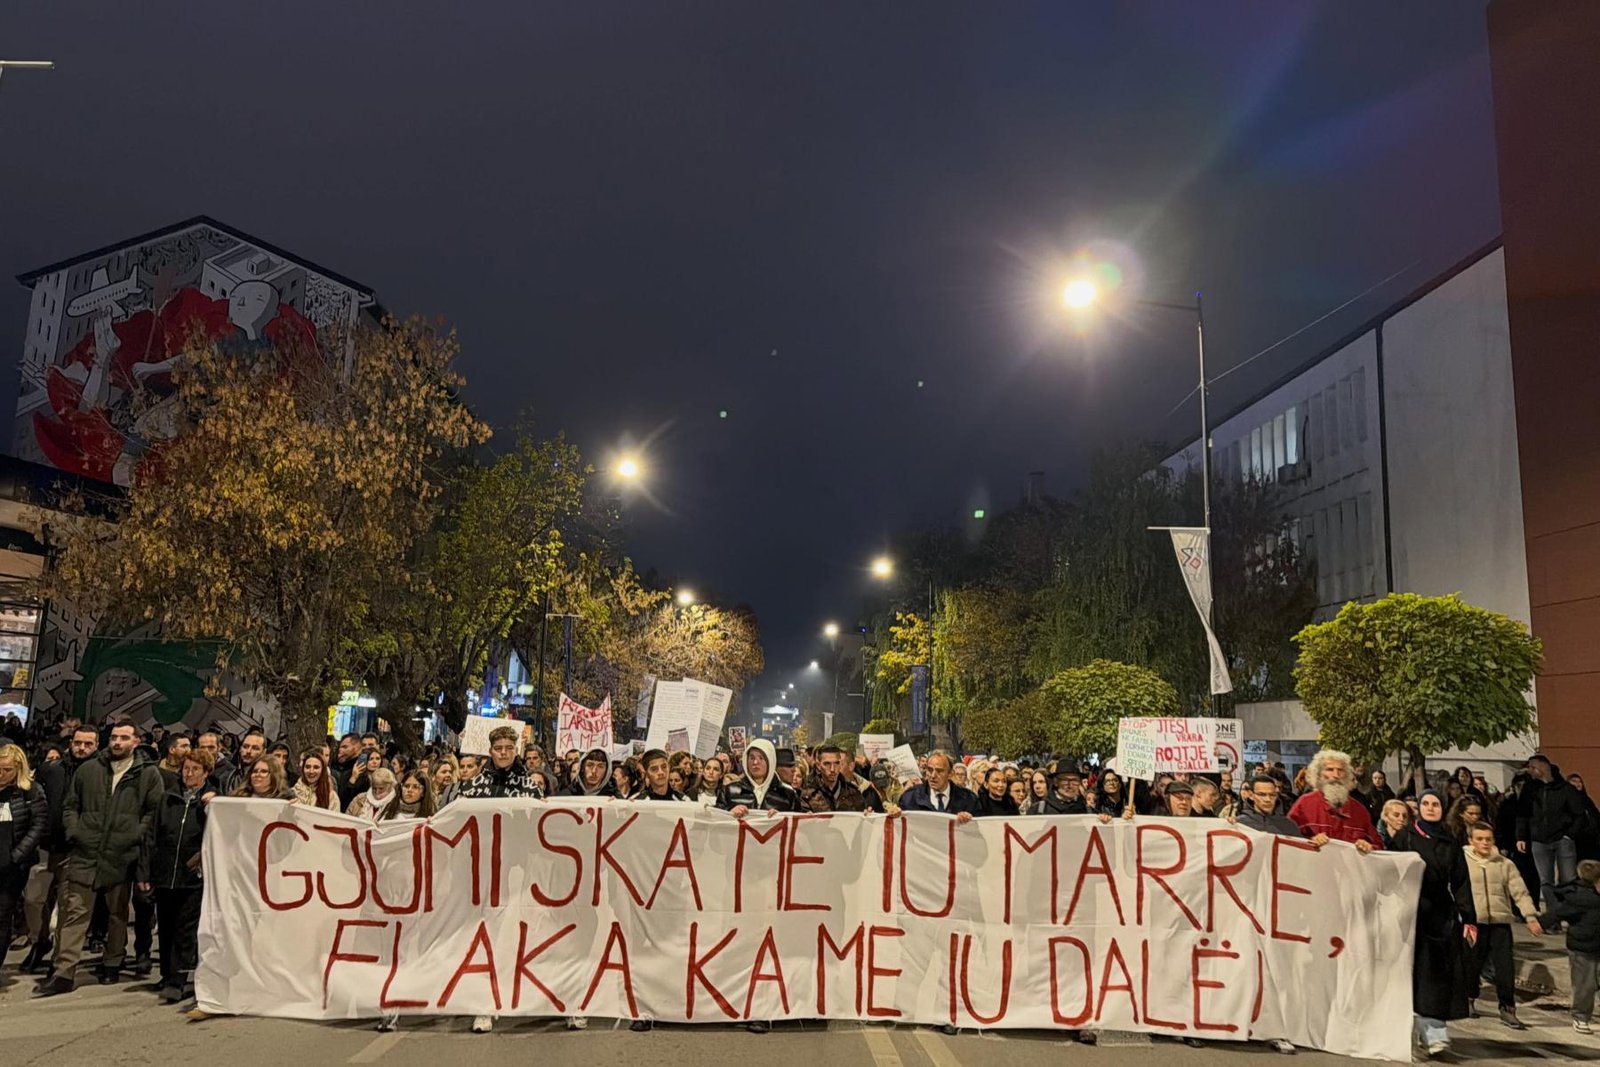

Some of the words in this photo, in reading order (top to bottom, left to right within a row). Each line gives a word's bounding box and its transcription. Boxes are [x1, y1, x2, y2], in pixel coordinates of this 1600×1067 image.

[1120, 719, 1147, 729] STOP
[1215, 722, 1236, 733] ONË
[1155, 745, 1208, 762] ROJTJE
[1122, 766, 1147, 777] STOP
[258, 814, 502, 915] GJUMI
[530, 807, 703, 911] S'KA
[734, 813, 833, 913] ME
[881, 811, 957, 918] IU
[1003, 822, 1344, 957] MARRE,
[324, 918, 640, 1020] FLAKA
[686, 921, 792, 1019] KA
[816, 922, 905, 1018] ME
[949, 931, 1014, 1026] IU
[1048, 934, 1264, 1037] DALË!
